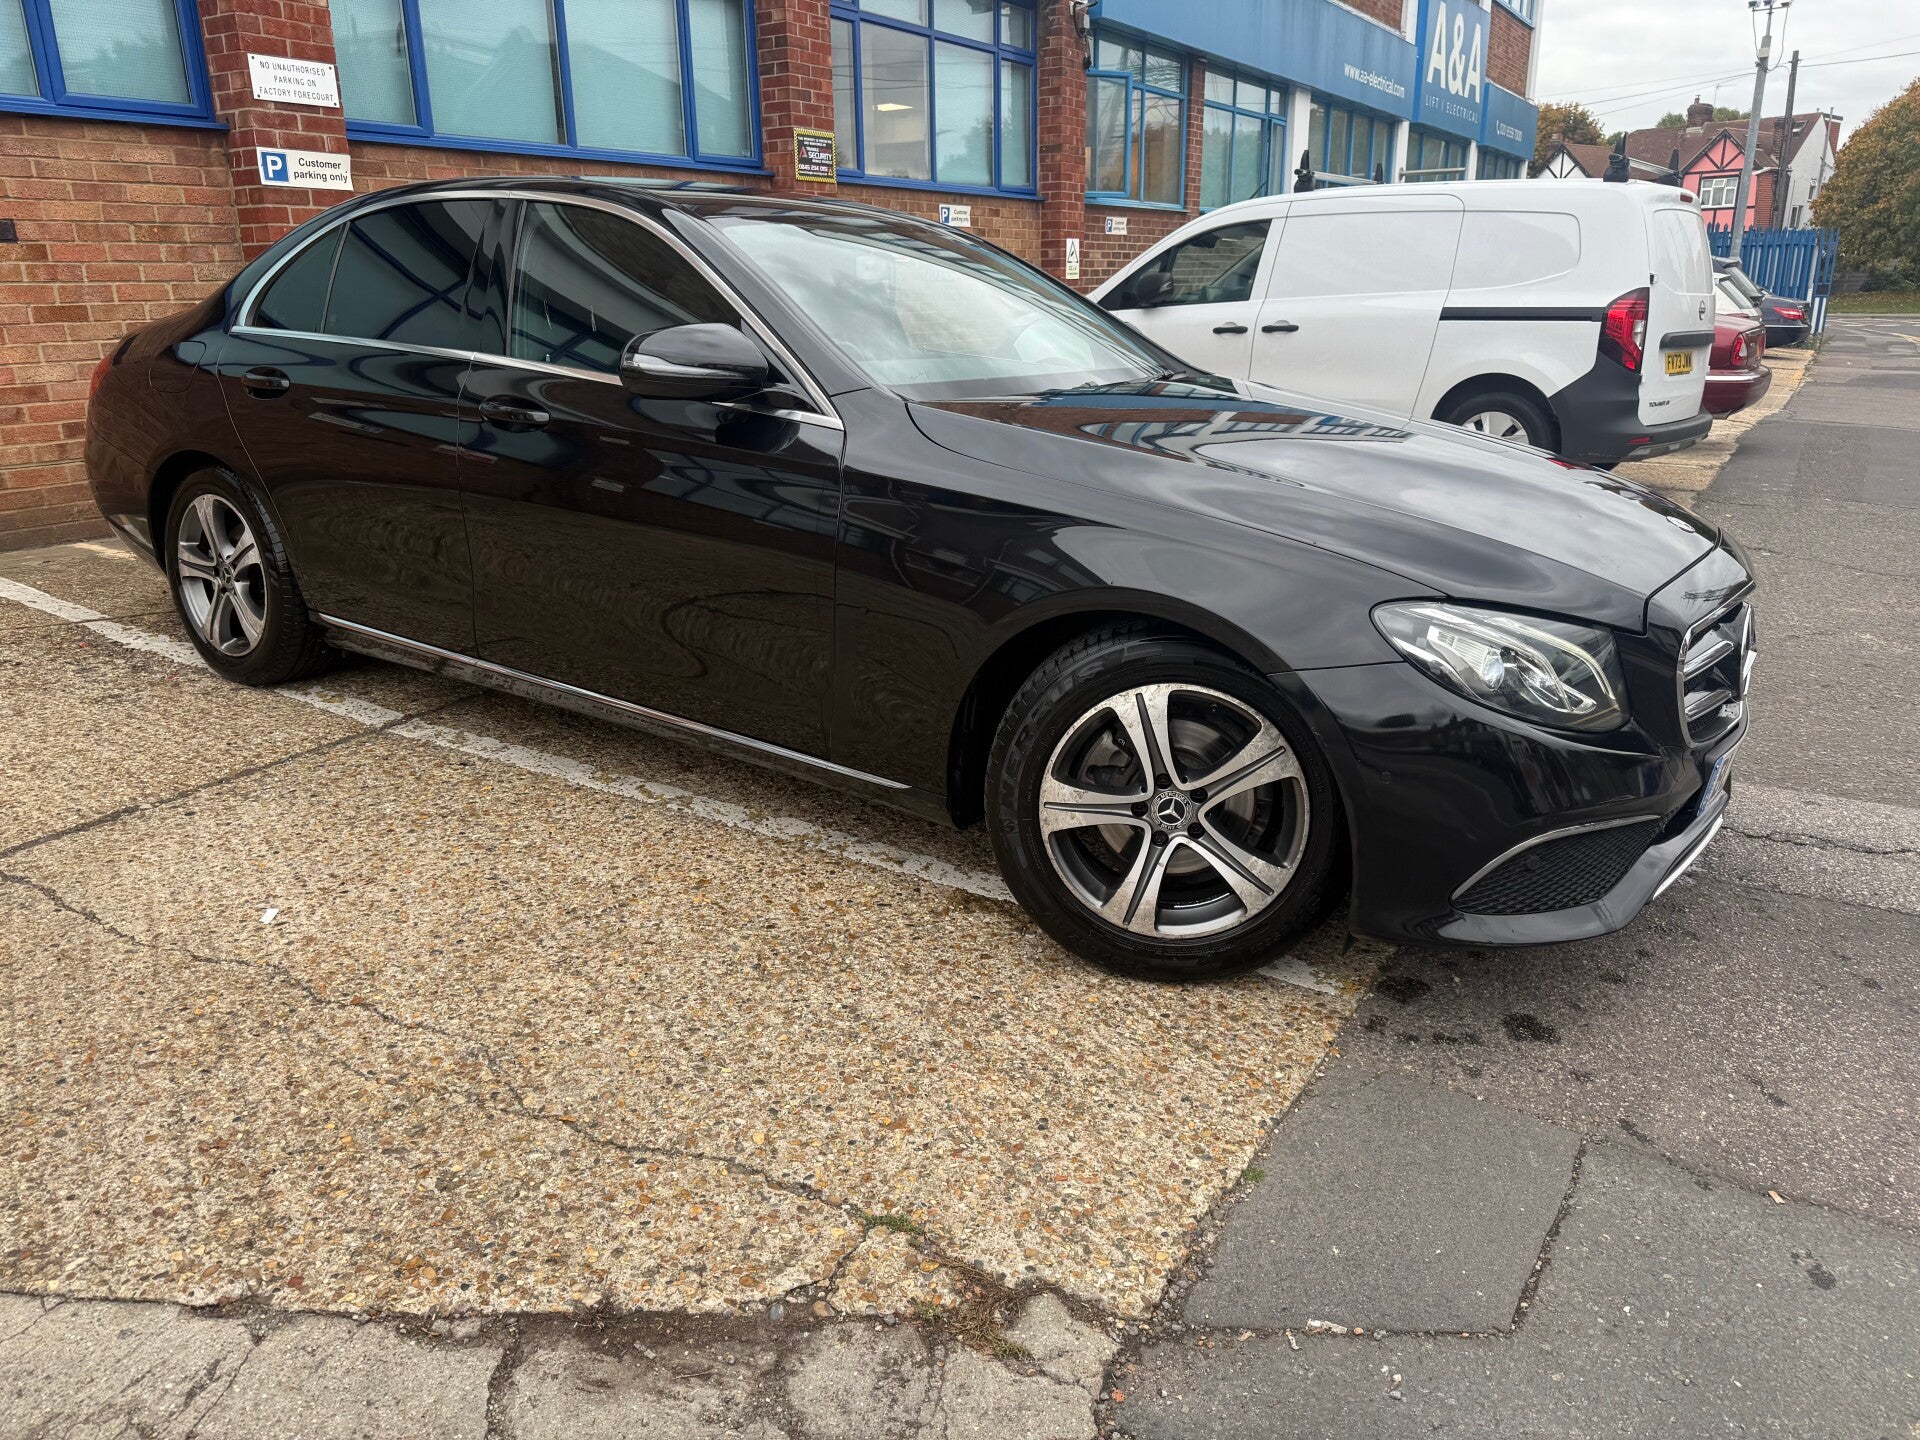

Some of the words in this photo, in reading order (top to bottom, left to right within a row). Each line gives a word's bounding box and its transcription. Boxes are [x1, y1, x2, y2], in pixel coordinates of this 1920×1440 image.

[1426, 1, 1481, 104] A&A
[259, 60, 270, 70] NO
[271, 62, 326, 77] UNAUTHORISED
[273, 75, 305, 87] PARKING
[307, 79, 317, 87] ON
[1344, 63, 1405, 99] www.aa-electrical.com
[259, 87, 291, 97] FACTORY
[293, 90, 333, 102] FORECOURT
[1425, 94, 1439, 109] LIFT
[1446, 102, 1478, 123] ELECTRICAL
[298, 157, 341, 170] Customer
[808, 151, 832, 161] SECURITY
[266, 155, 283, 178] P
[293, 170, 327, 182] parking
[329, 174, 348, 183] only
[942, 208, 949, 222] P
